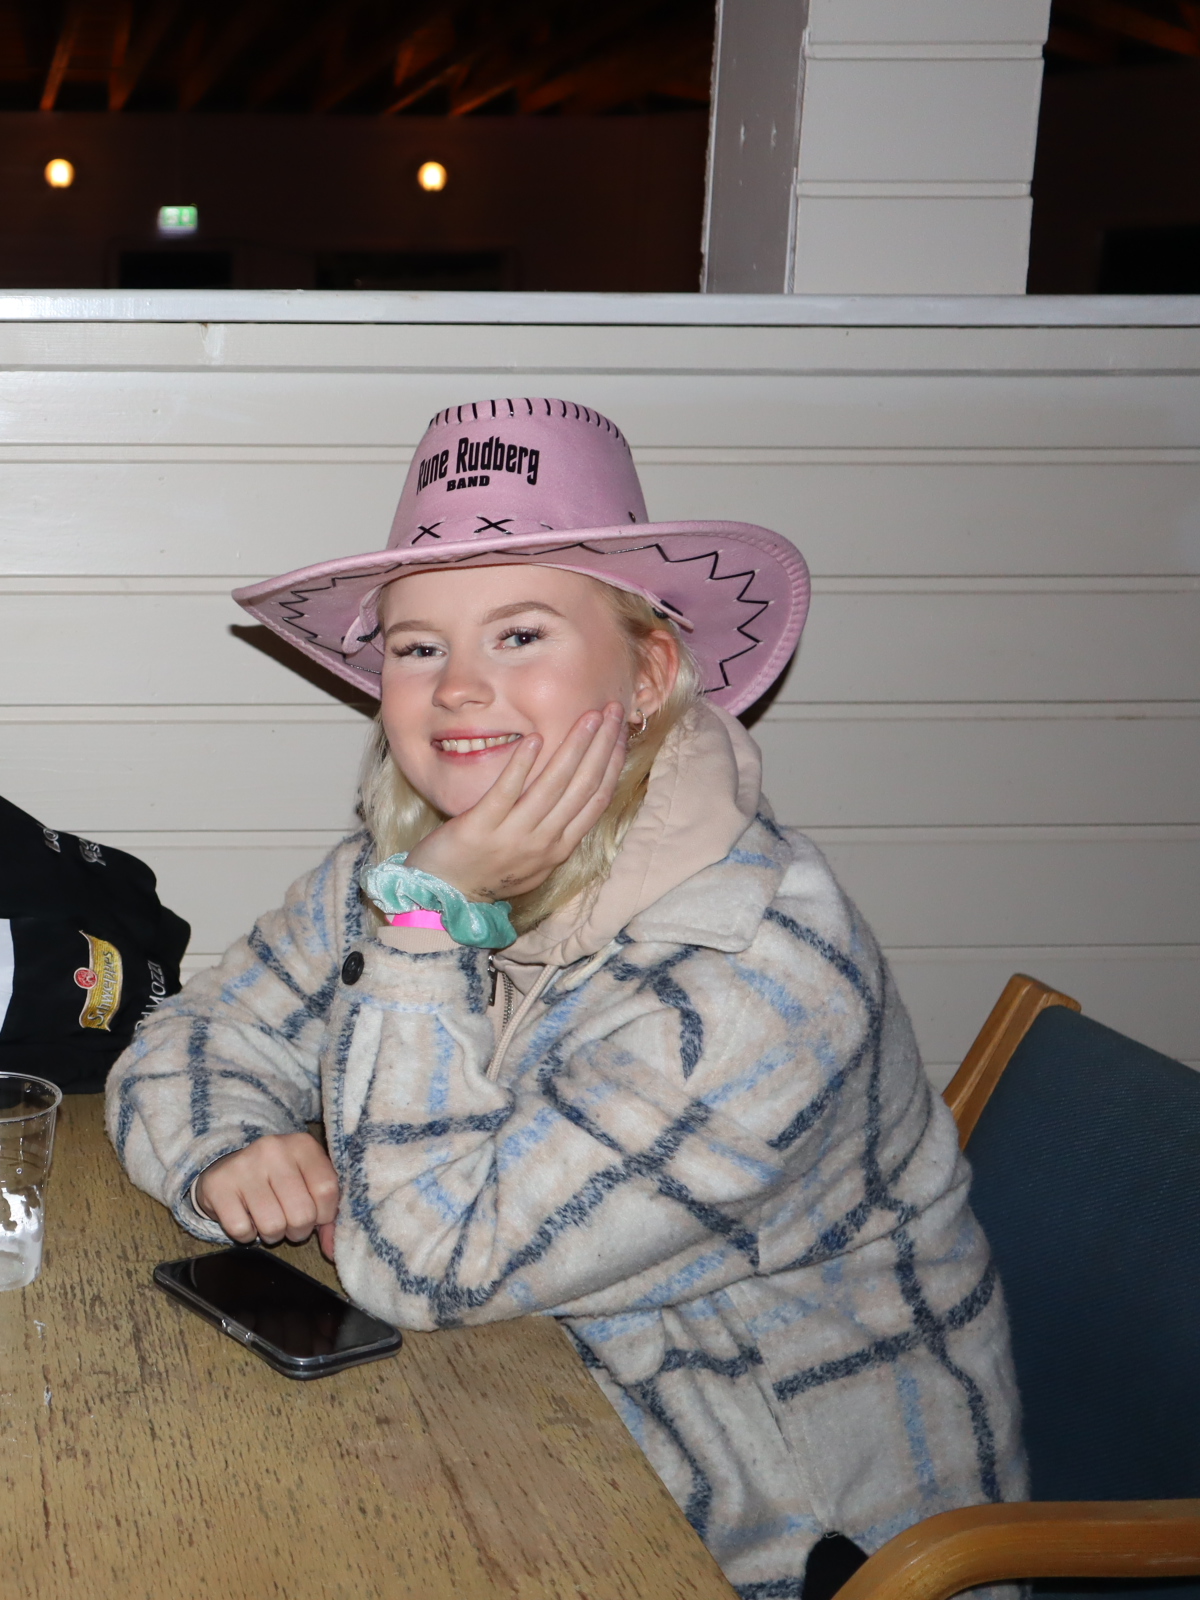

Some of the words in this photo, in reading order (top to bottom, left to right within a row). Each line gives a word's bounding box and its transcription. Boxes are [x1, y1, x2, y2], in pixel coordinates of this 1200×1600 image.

[416, 449, 450, 495] Rune
[455, 436, 540, 486] Rudberg
[446, 475, 490, 492] BAND
[87, 950, 115, 1026] Schweppes
